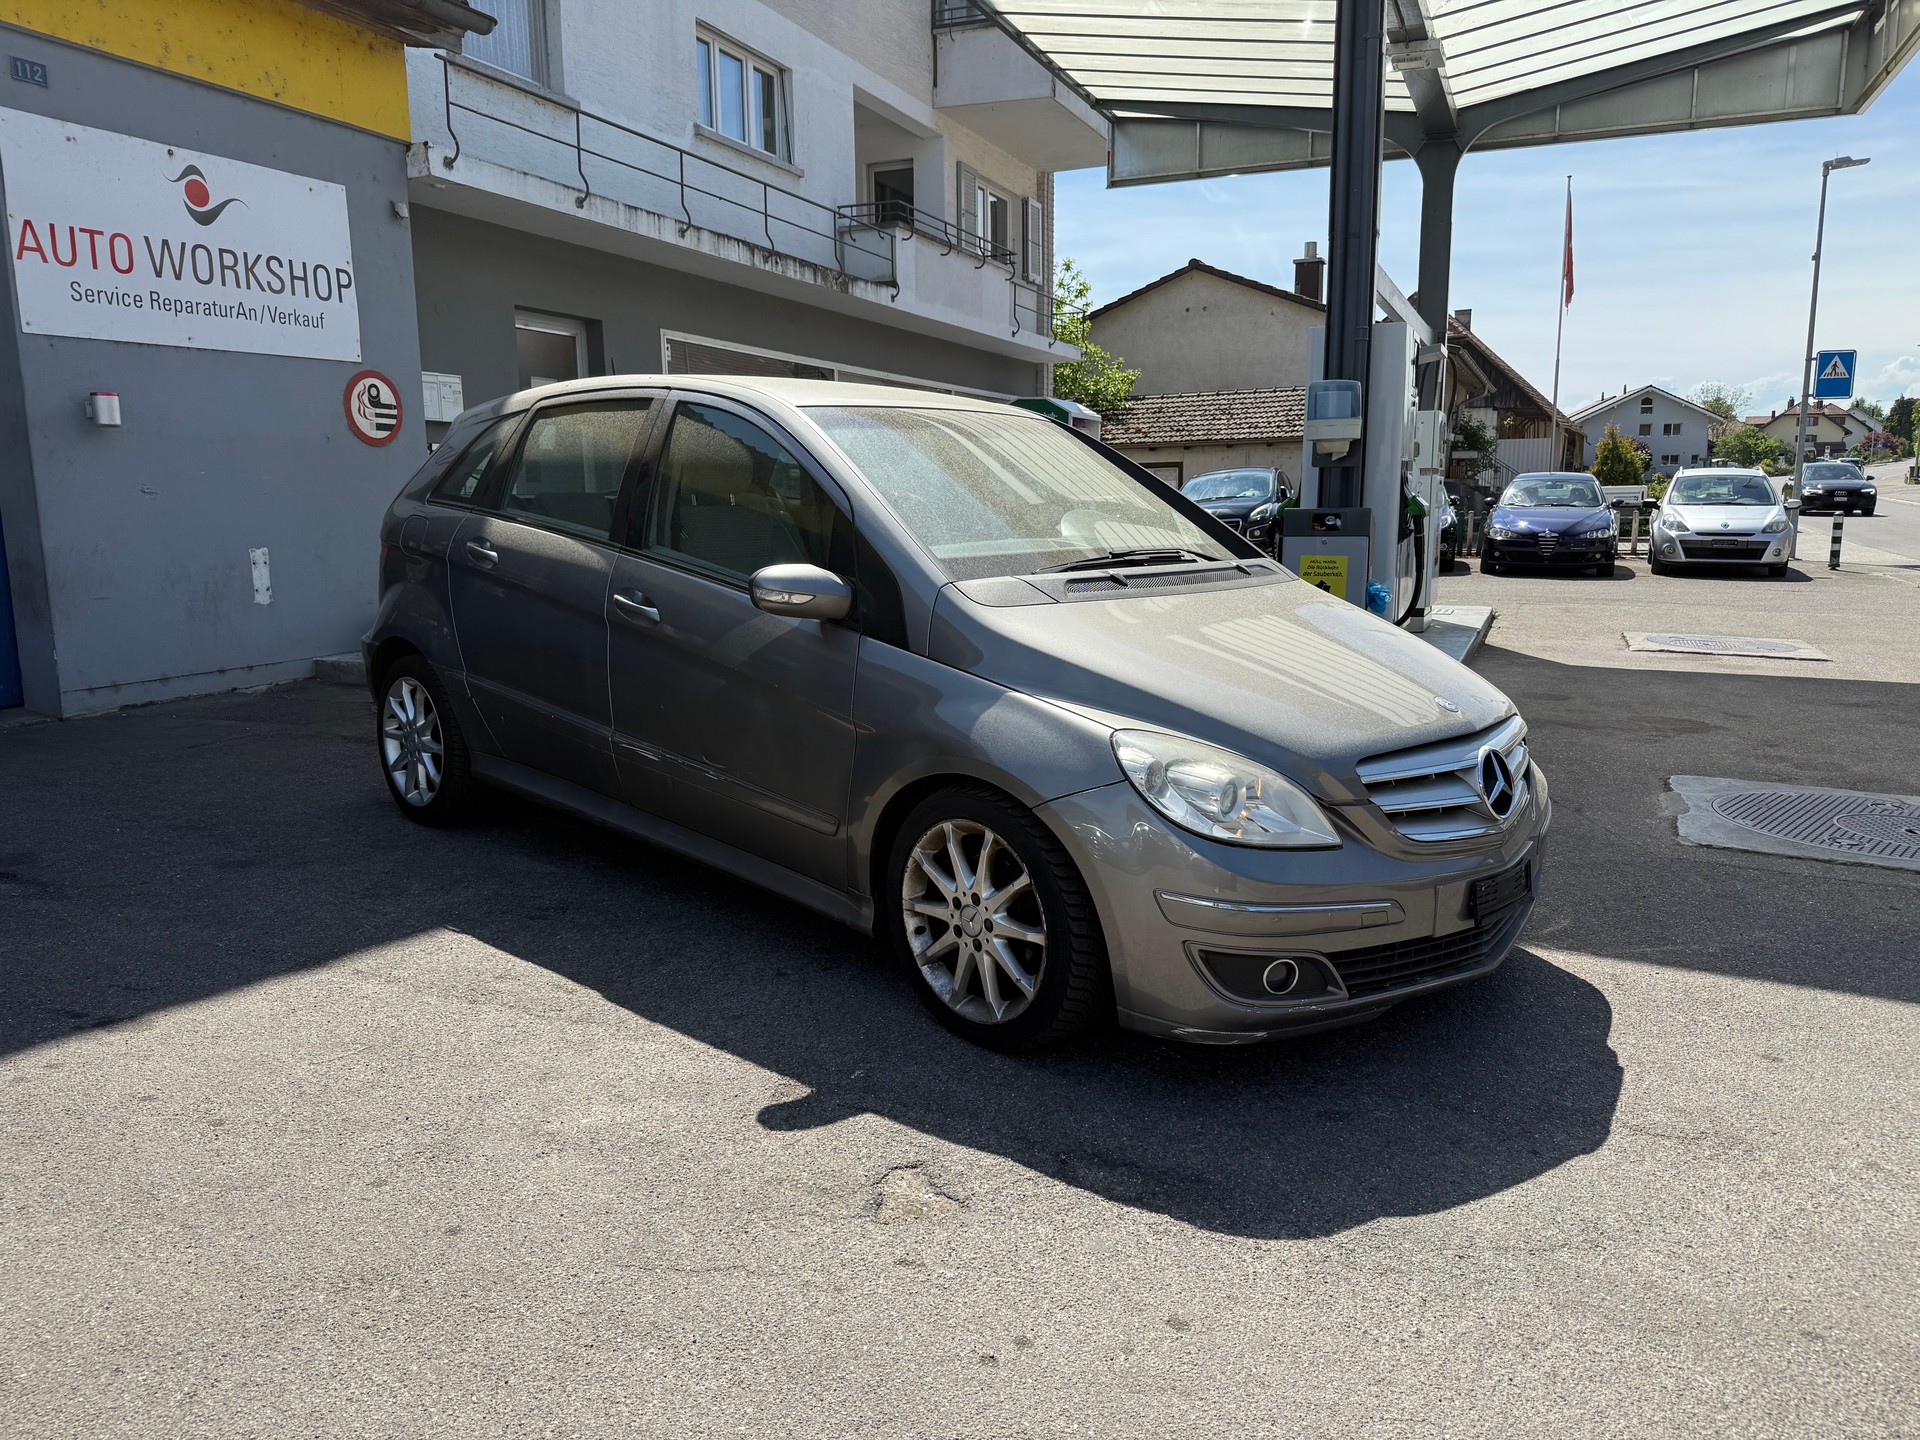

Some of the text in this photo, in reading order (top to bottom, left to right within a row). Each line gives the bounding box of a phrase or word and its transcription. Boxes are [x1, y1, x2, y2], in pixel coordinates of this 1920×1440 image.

[16, 61, 43, 82] 112
[16, 219, 353, 304] AUTO WORKSHOP
[70, 281, 143, 310] Service
